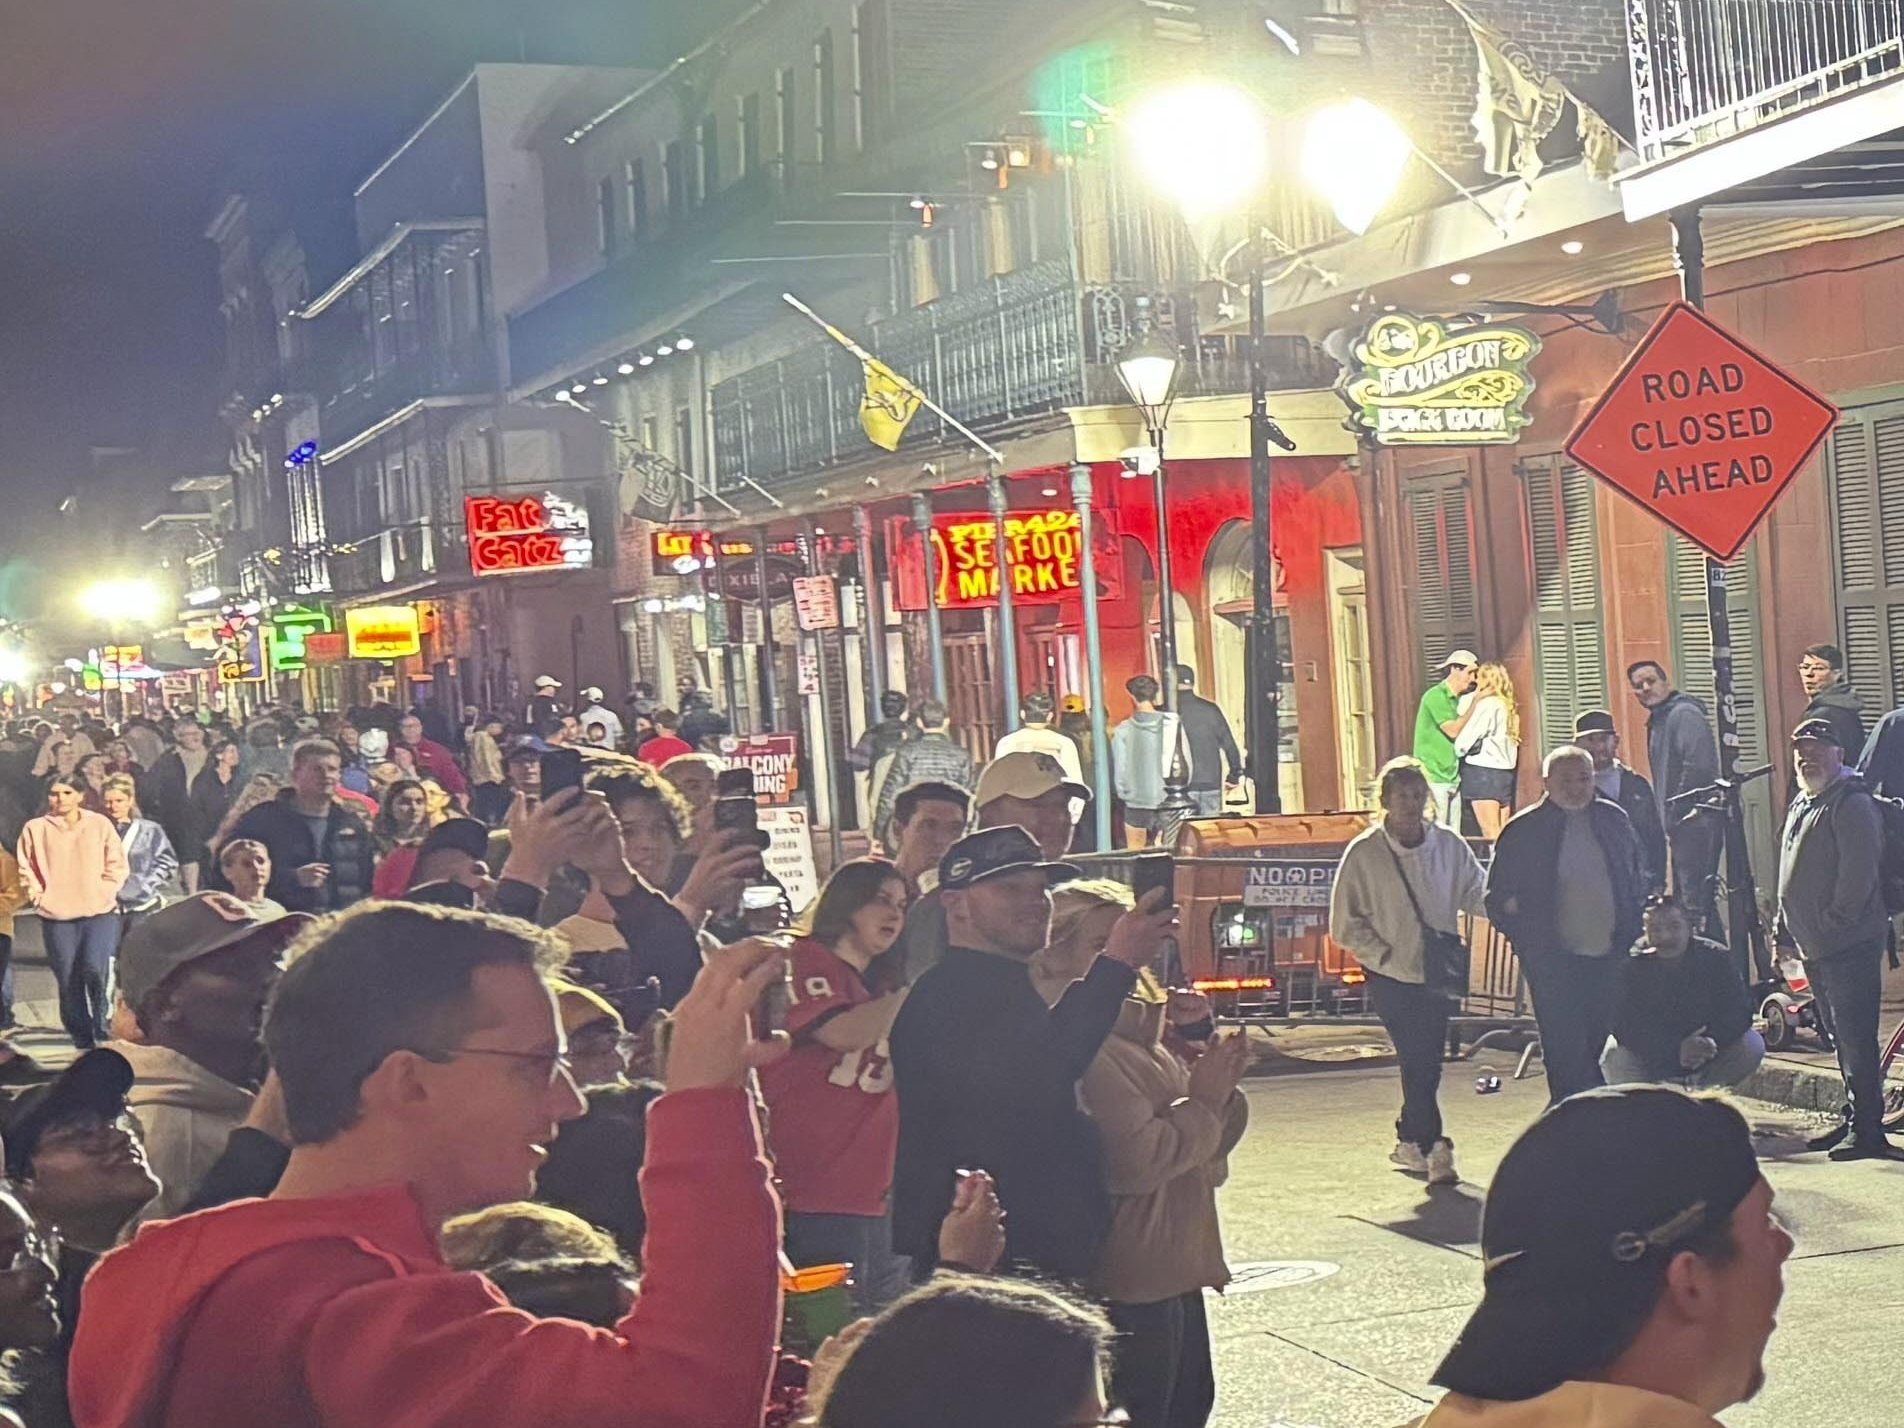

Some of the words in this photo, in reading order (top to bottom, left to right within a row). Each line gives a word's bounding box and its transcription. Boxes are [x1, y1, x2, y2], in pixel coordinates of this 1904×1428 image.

[1641, 363, 1744, 403] ROAD
[1631, 406, 1773, 452] CLOSED
[1652, 454, 1774, 499] AHEAD
[474, 498, 542, 533] Fat
[958, 557, 1080, 599] MARKE
